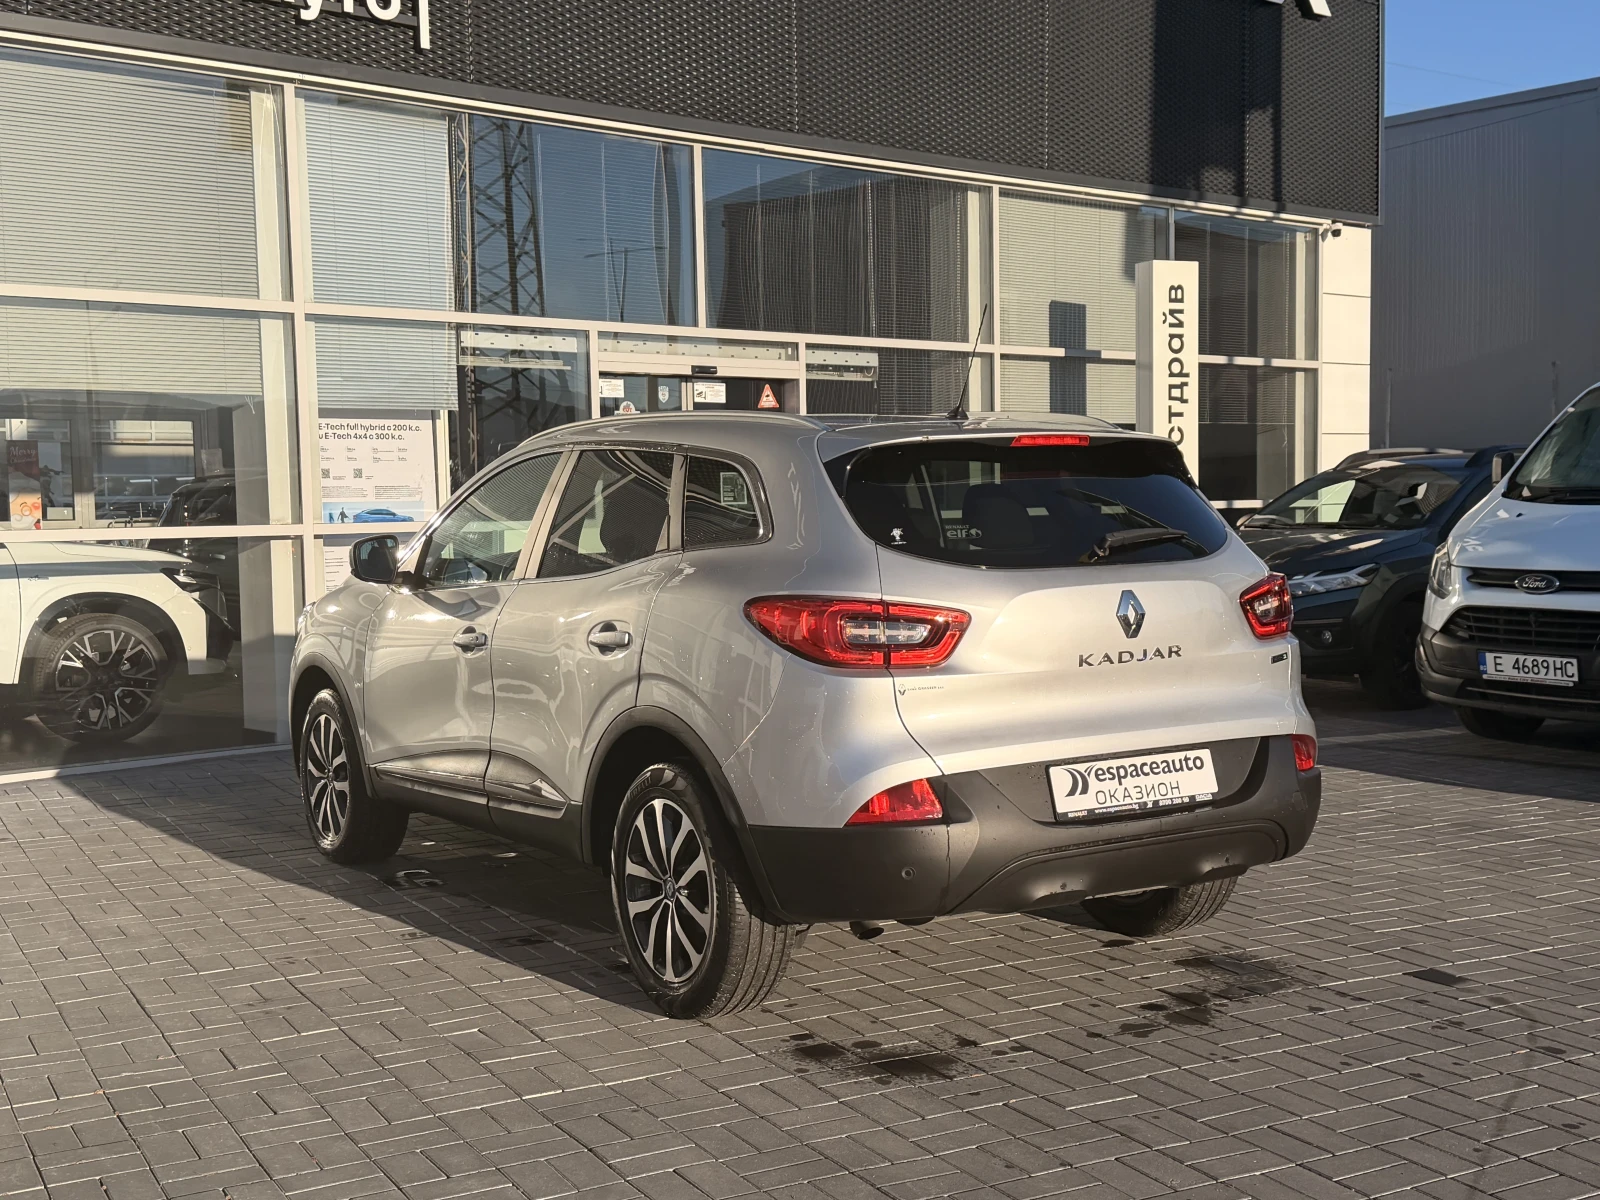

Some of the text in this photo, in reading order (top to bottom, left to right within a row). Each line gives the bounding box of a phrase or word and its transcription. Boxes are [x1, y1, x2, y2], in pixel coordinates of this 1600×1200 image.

[1163, 284, 1190, 448] стдрайв
[318, 423, 345, 431] E-Tech
[346, 423, 359, 431] full
[360, 423, 386, 432] hybrid
[324, 432, 352, 440] E-Tech
[353, 432, 368, 440] 4x4
[374, 432, 390, 440] 300
[946, 529, 969, 538] elf
[1522, 577, 1546, 588] Ford
[1078, 645, 1182, 668] KADJAR
[1493, 655, 1575, 678] E 4689 HC
[1094, 753, 1205, 785] espaceauto
[1095, 780, 1181, 805] ОКАЗИОН
